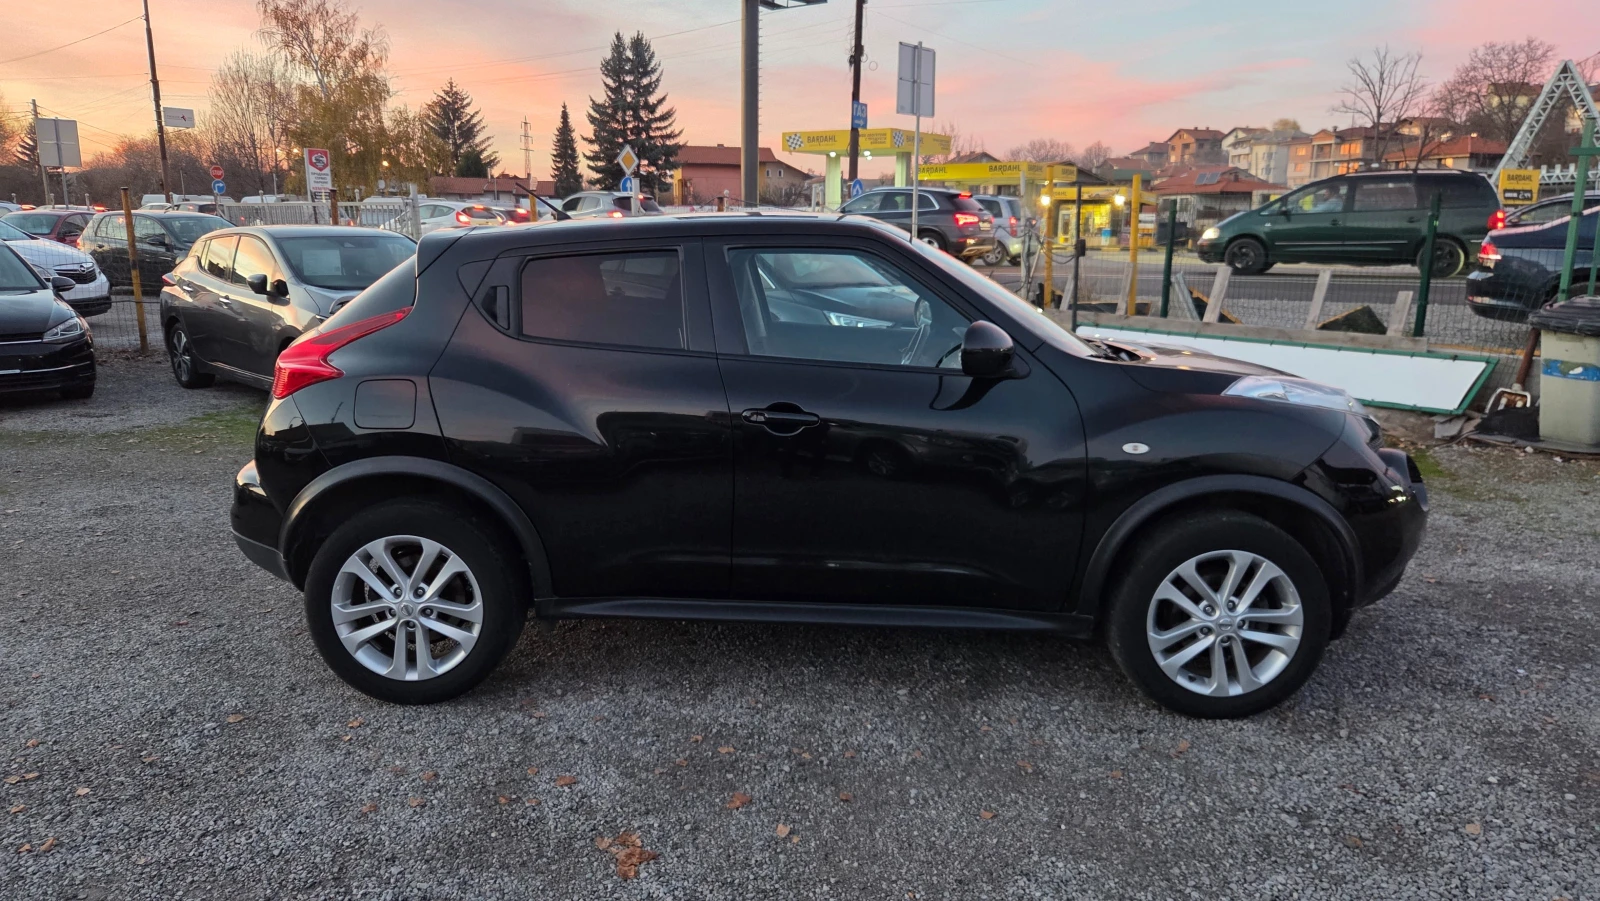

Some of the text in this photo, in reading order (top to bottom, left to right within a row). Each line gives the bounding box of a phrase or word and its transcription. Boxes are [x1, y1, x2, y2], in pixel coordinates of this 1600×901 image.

[853, 103, 867, 118] ГАЗ
[807, 135, 837, 145] BARDAHL
[988, 164, 1022, 174] BARDAHL
[1507, 174, 1532, 183] BARDAHL
